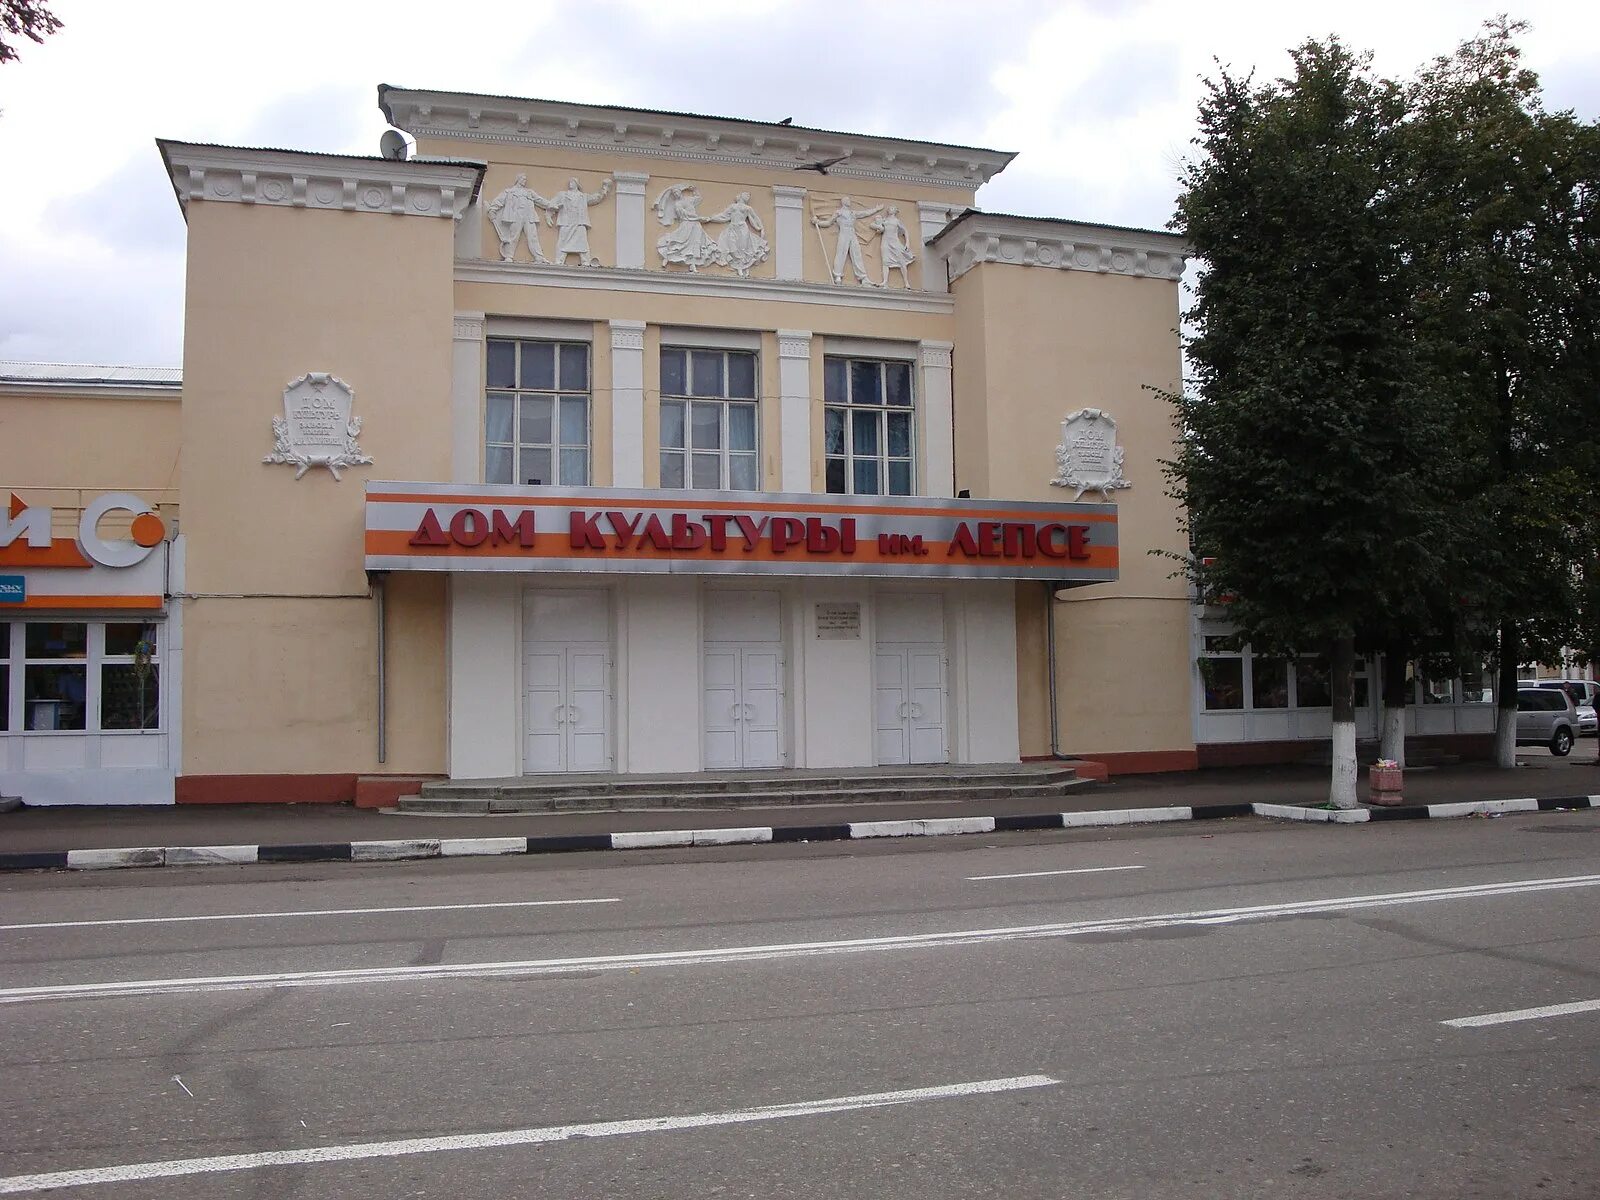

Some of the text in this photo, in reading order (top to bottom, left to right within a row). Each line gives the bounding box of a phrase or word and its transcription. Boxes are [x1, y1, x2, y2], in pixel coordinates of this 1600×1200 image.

[408, 507, 536, 548] ДОМ
[569, 510, 857, 554] КУЛЬТУРЫ
[947, 521, 1091, 560] ЛЕПСЕ
